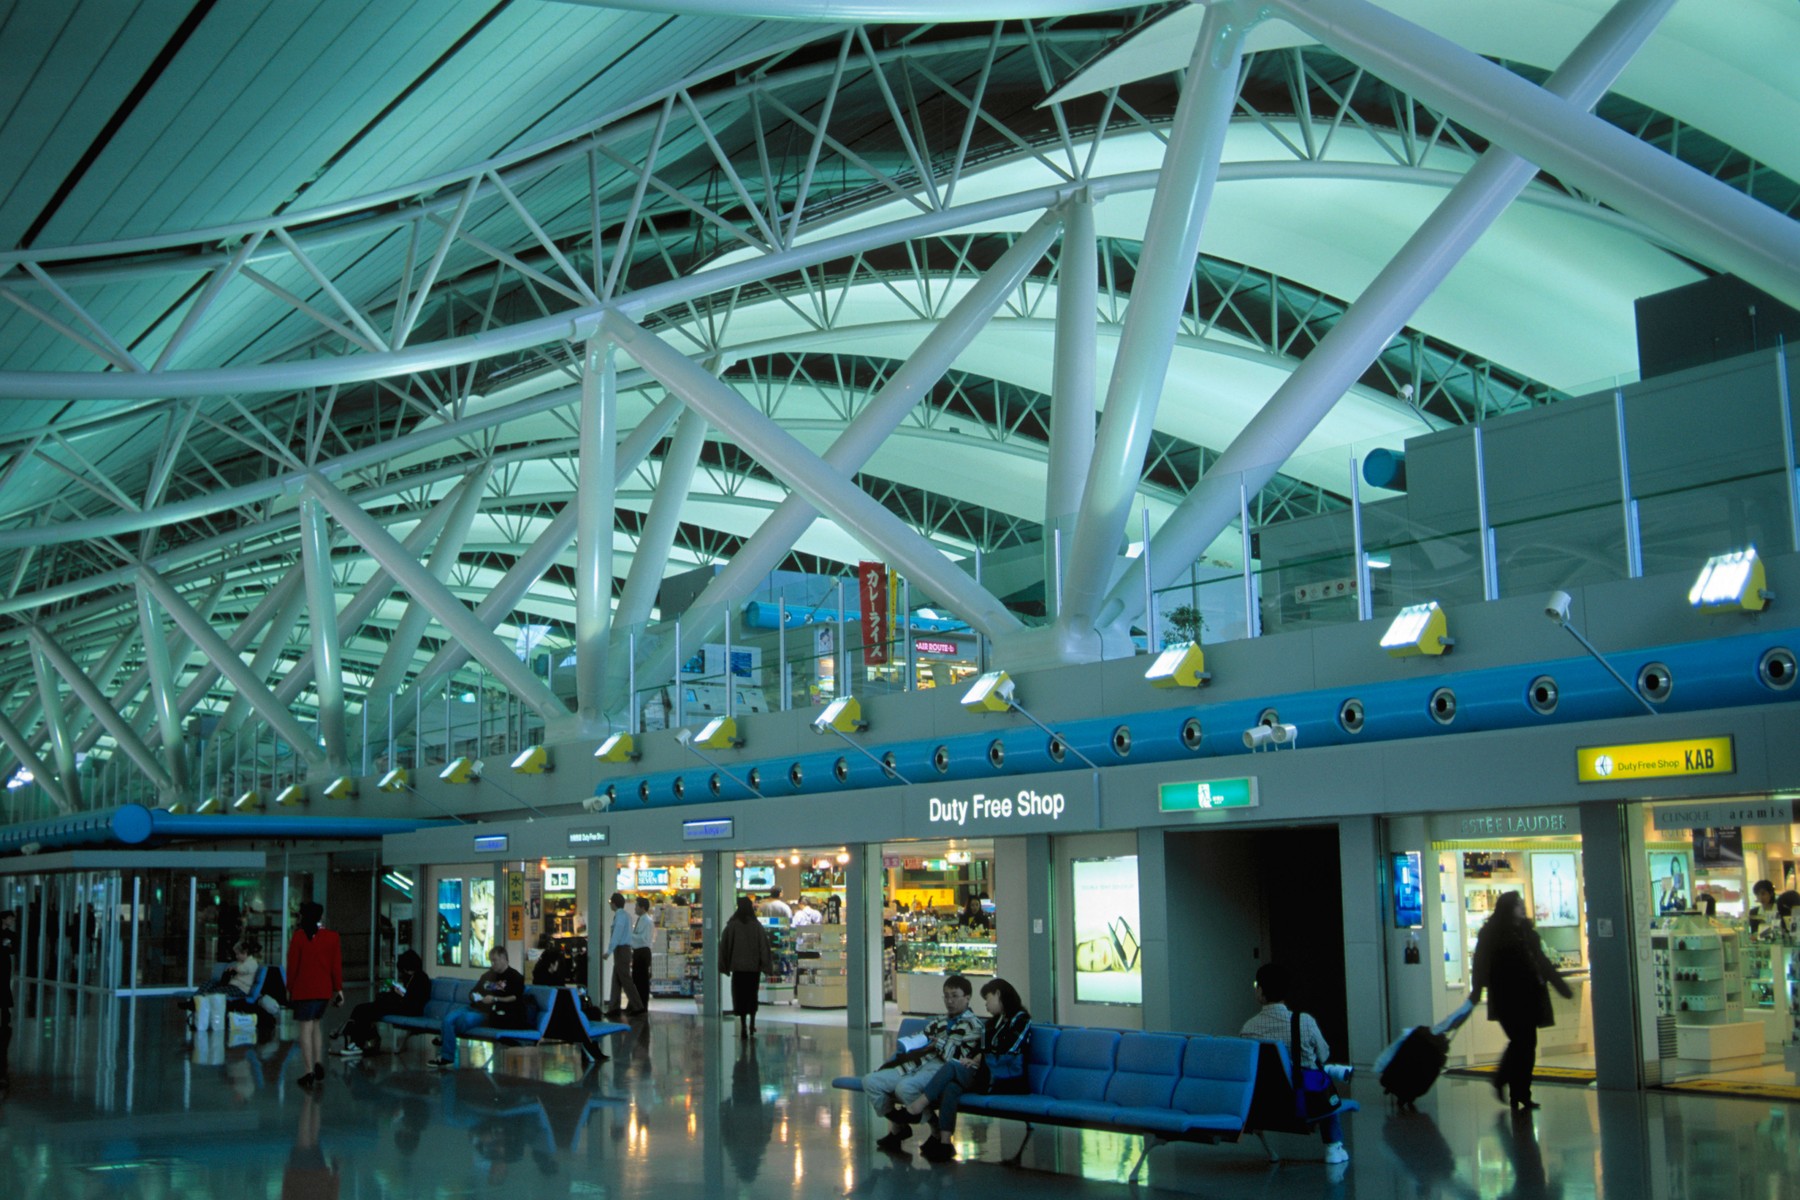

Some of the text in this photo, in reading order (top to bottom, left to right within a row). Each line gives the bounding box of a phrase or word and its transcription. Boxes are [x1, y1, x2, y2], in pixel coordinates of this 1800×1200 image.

[866, 570, 882, 657] カレーライス
[918, 642, 928, 651] AIR
[1618, 748, 1714, 772] Duty Free Shop KAB
[929, 790, 1065, 826] Duty Free Shop
[1662, 810, 1709, 823] CLINIQUE
[1730, 806, 1785, 820] aramis
[1508, 814, 1567, 832] LAUDER
